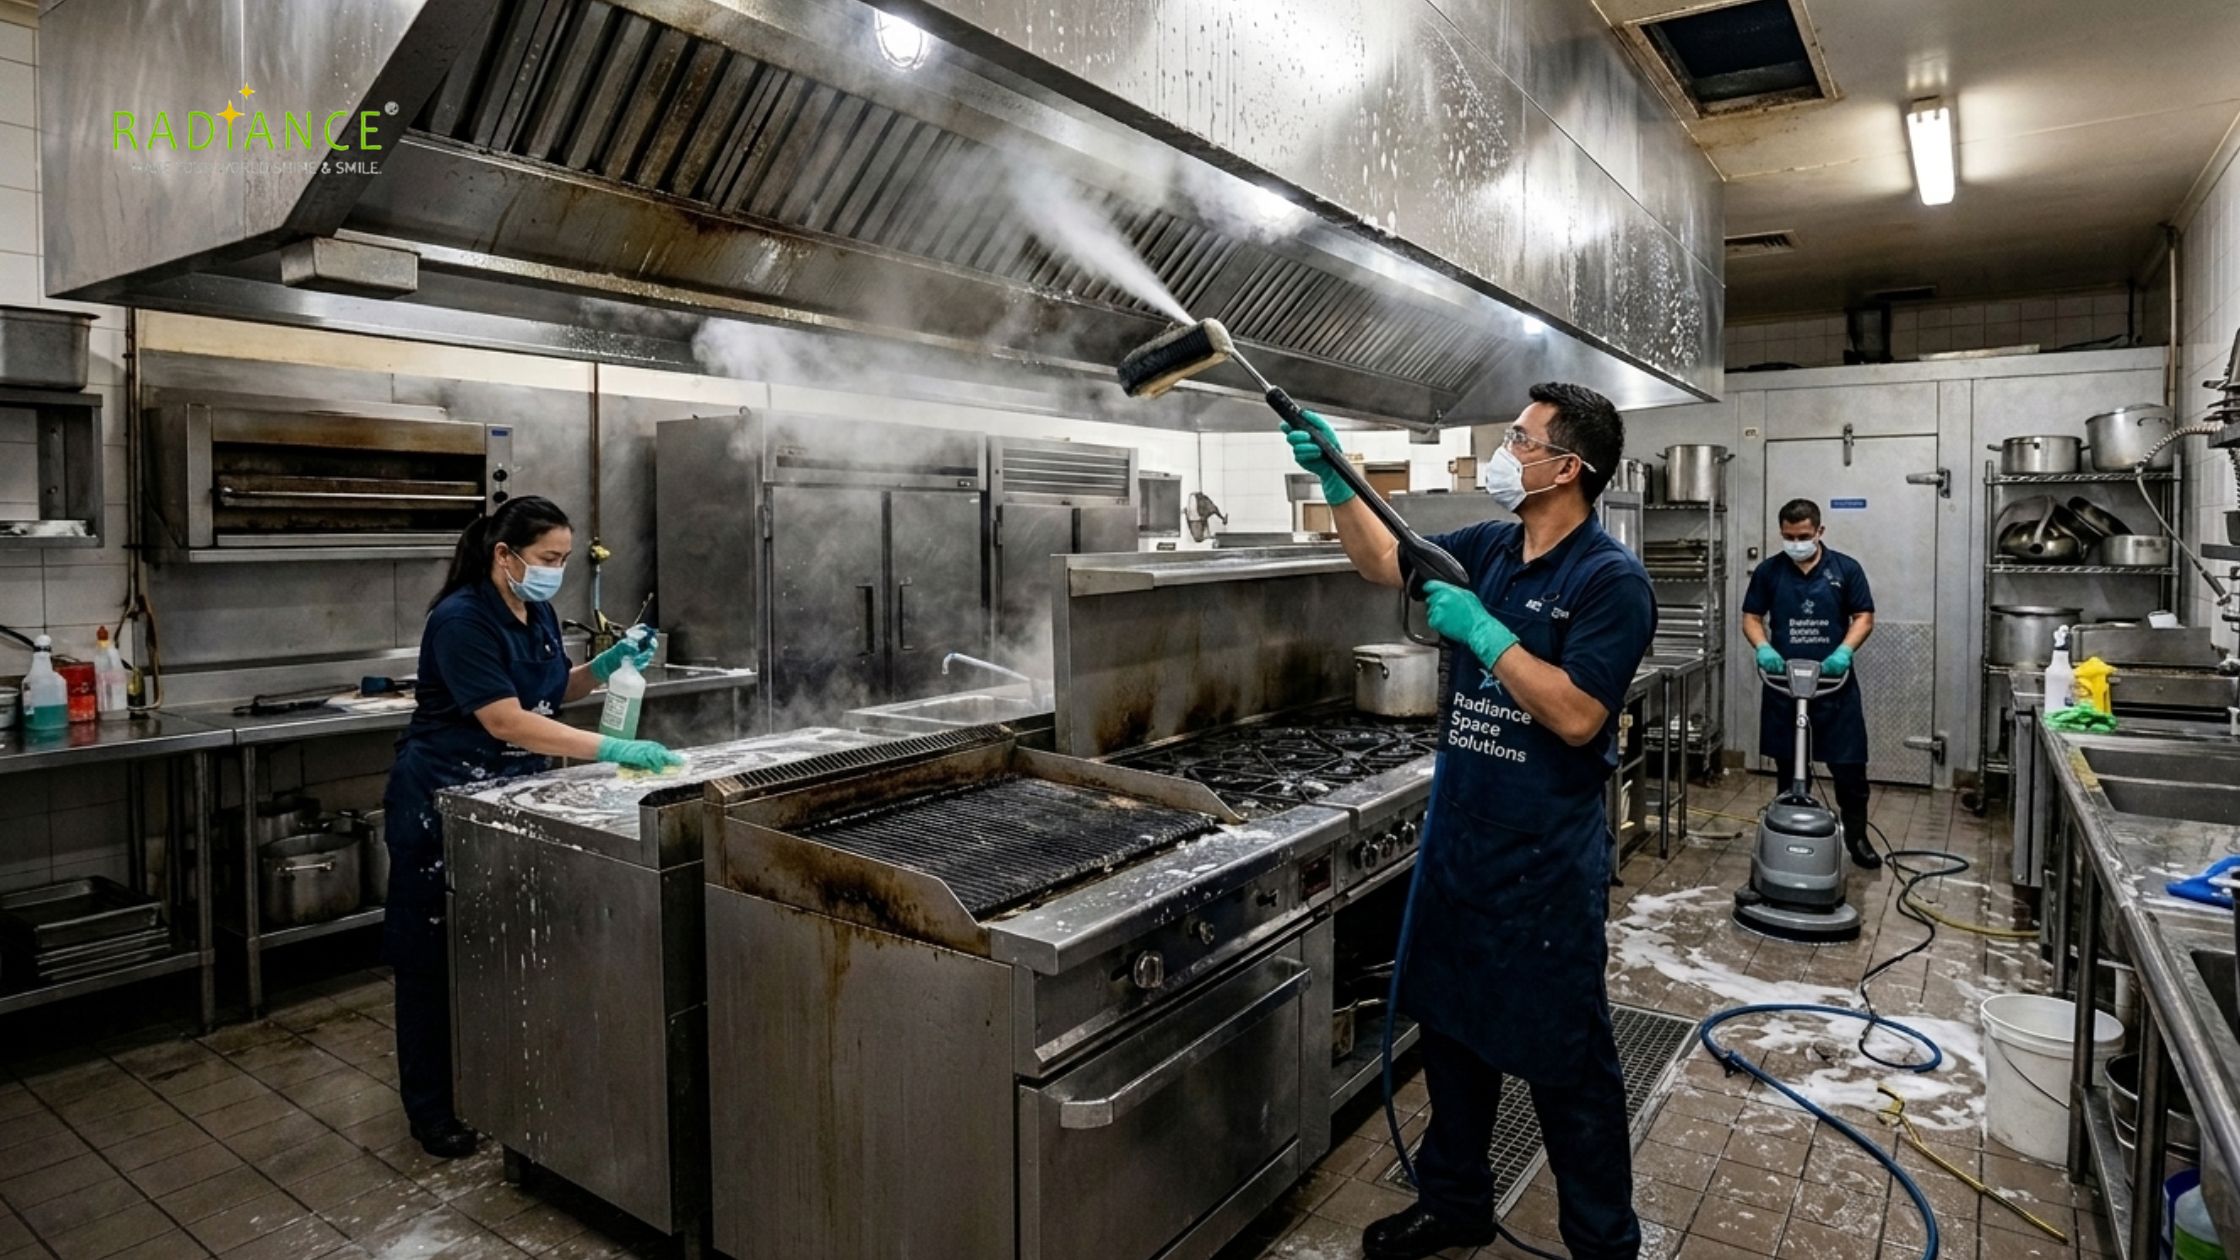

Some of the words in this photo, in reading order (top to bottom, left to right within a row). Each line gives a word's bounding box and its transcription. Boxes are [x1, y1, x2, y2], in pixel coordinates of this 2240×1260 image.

[1451, 711, 1501, 737] Space
[1453, 692, 1533, 725] Radiance
[1448, 729, 1527, 763] Solutions
